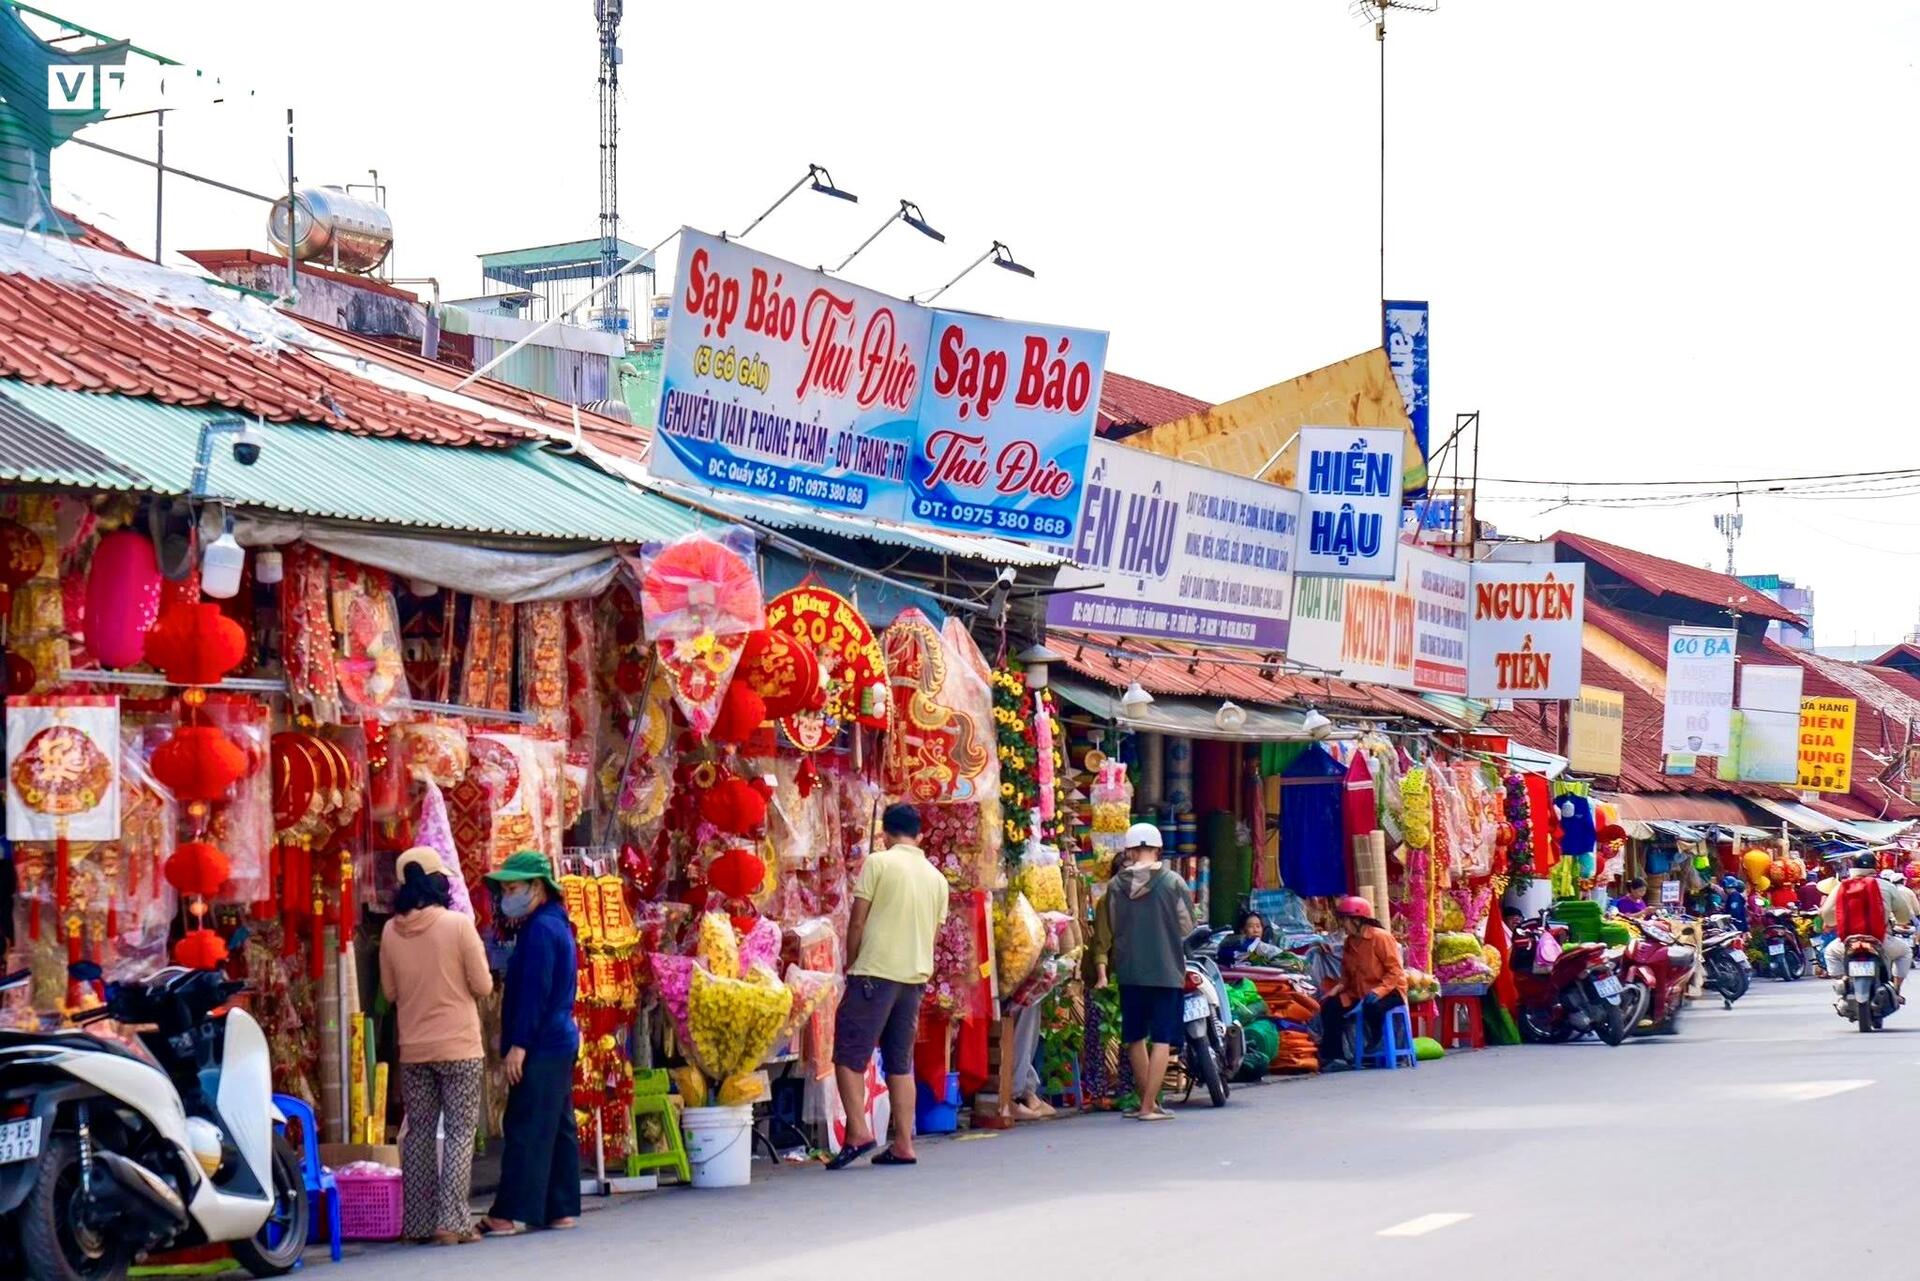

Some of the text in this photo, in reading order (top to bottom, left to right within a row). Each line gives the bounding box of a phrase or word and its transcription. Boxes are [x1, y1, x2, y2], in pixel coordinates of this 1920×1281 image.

[686, 248, 916, 409] Sạp Báo Thủ Đức
[694, 345, 769, 395] (3 CÔ GÁI)
[934, 325, 1090, 418] Sạp Báo
[664, 389, 718, 440] CHUYÊN
[720, 396, 748, 446] VĂN
[748, 404, 791, 457] PHÒNG
[791, 409, 828, 464] PHẨM
[854, 435, 890, 477] TRANG
[890, 437, 910, 480] TRÍ
[708, 457, 728, 478] ĐC:
[755, 466, 771, 487] Số
[769, 471, 777, 489] 2
[788, 475, 805, 495] ĐT:
[805, 479, 828, 499] 0975
[828, 483, 846, 503] 380
[847, 487, 864, 505] 868
[925, 430, 1071, 497] Thủ Đức
[918, 501, 1066, 535] ĐT: 0975 380 868
[1118, 480, 1179, 592] HẬU
[1309, 503, 1383, 566] HẬU
[1475, 571, 1575, 621] NGUYÊN
[792, 617, 861, 663] 2026
[1801, 733, 1835, 748] GIA
